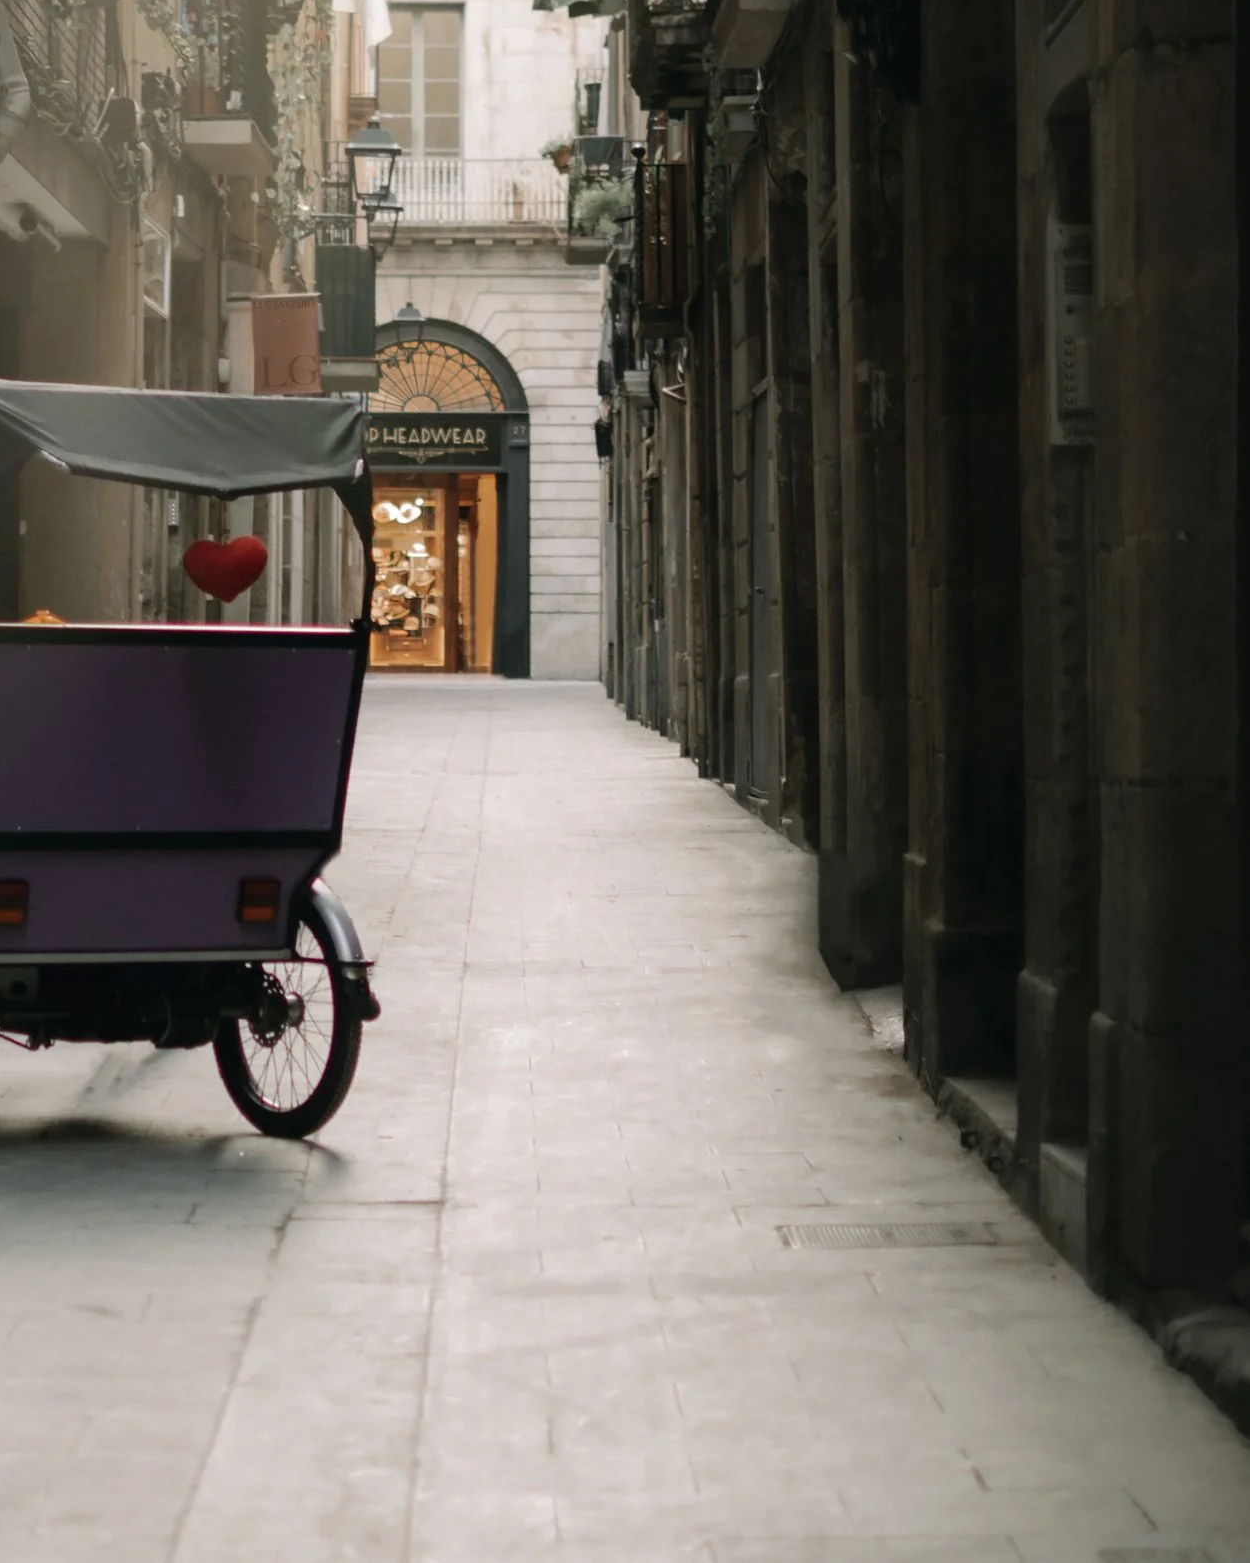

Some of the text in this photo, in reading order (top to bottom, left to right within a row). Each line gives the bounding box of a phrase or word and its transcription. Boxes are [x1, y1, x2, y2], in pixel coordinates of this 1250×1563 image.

[262, 354, 318, 388] LG
[364, 426, 486, 444] P HEADWEAR
